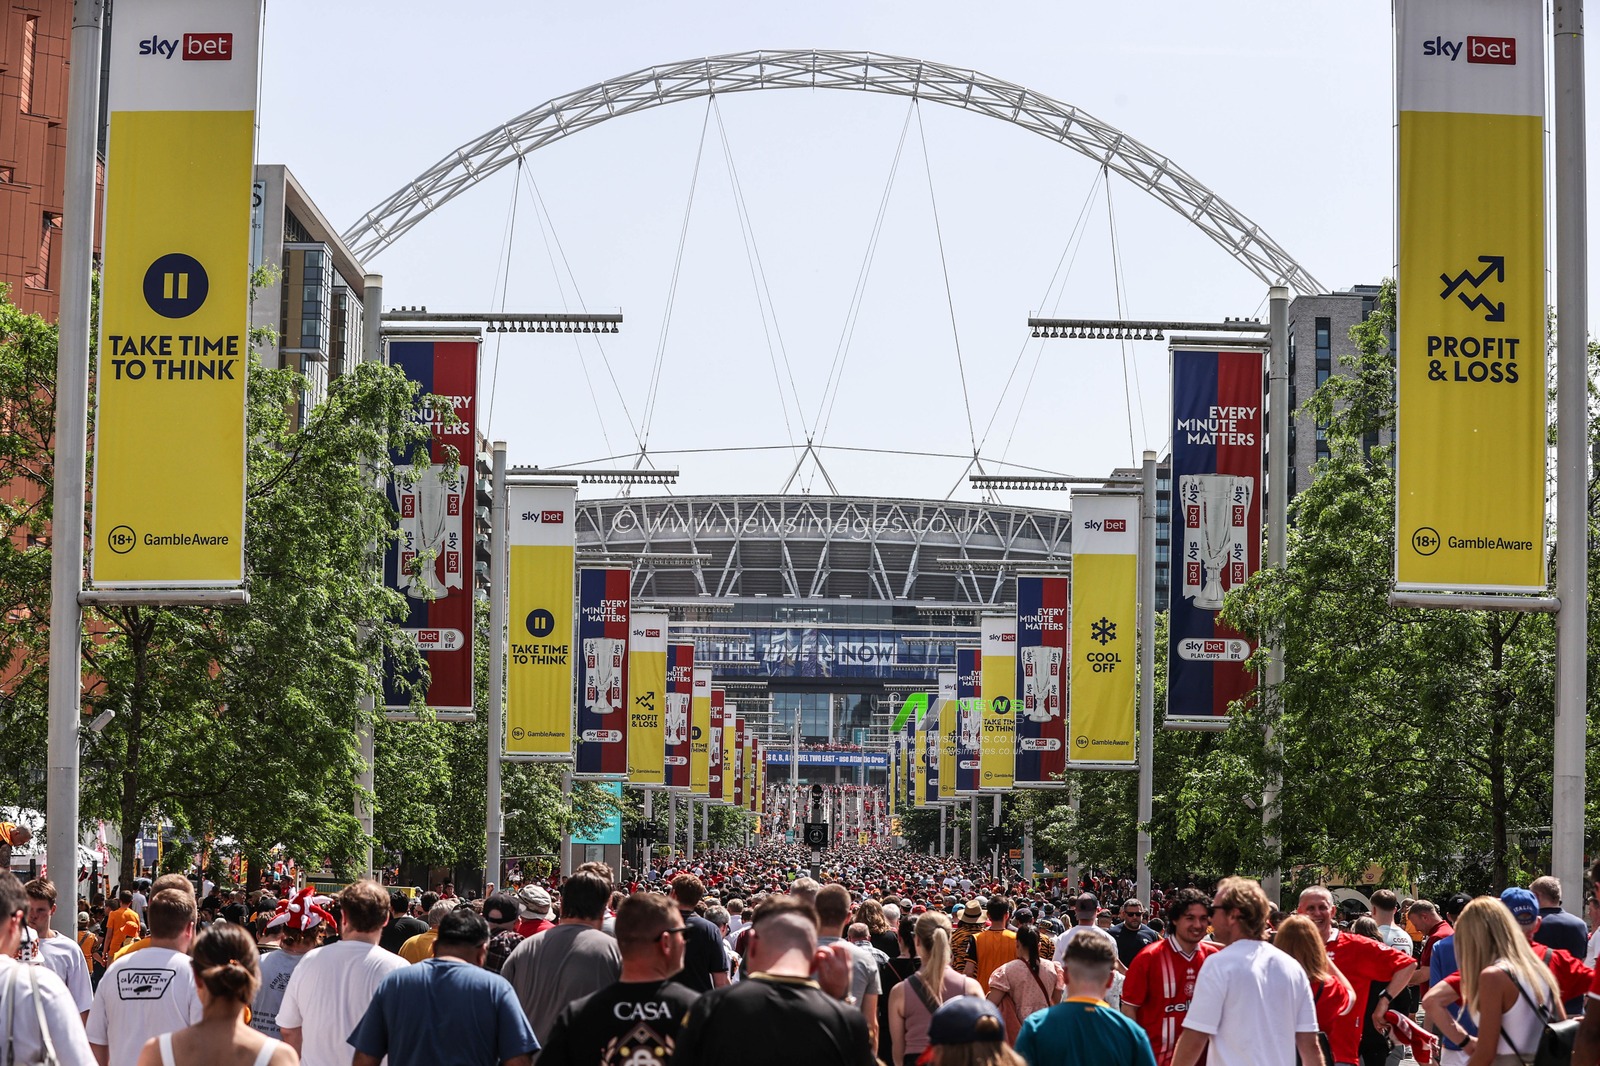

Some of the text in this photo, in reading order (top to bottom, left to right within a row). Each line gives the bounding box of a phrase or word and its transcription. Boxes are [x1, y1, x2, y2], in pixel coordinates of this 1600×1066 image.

[139, 35, 228, 60] sky bet
[1423, 36, 1512, 61] sky bet
[109, 335, 239, 356] TAKE TIME
[1427, 335, 1520, 360] PROFIT
[111, 359, 146, 380] TO
[1427, 359, 1519, 384] & LOSS
[1209, 406, 1257, 419] EVERY
[1187, 432, 1255, 446] MATTERS
[404, 497, 413, 516] bet
[449, 496, 458, 514] bet
[1188, 484, 1199, 526] sky bet
[1232, 485, 1244, 525] sky bet
[522, 511, 562, 523] sky bet
[1084, 520, 1124, 531] sky bet
[112, 533, 229, 546] 18+ GambleAware
[1416, 536, 1533, 551] 18+ GambleAware
[447, 532, 458, 571] sky bet
[1187, 541, 1199, 583] sky bet
[1232, 543, 1243, 582] sky bet
[600, 599, 627, 608] EVERY
[588, 614, 627, 622] MATTERS
[1037, 607, 1065, 616] EVERY
[633, 629, 645, 637] sky
[1025, 622, 1064, 631] MATTERS
[420, 631, 438, 640] bet
[989, 633, 1001, 641] sky
[512, 644, 568, 654] TAKE TIME
[716, 643, 893, 663] THE TIME IS NOW
[1185, 641, 1223, 652] sky bet
[513, 655, 567, 665] TO THINK
[1086, 652, 1121, 662] COOL
[1092, 663, 1116, 673] OFF
[1092, 738, 1130, 746] GambleAware
[128, 972, 162, 984] VANS
[613, 1000, 673, 1020] CASA
